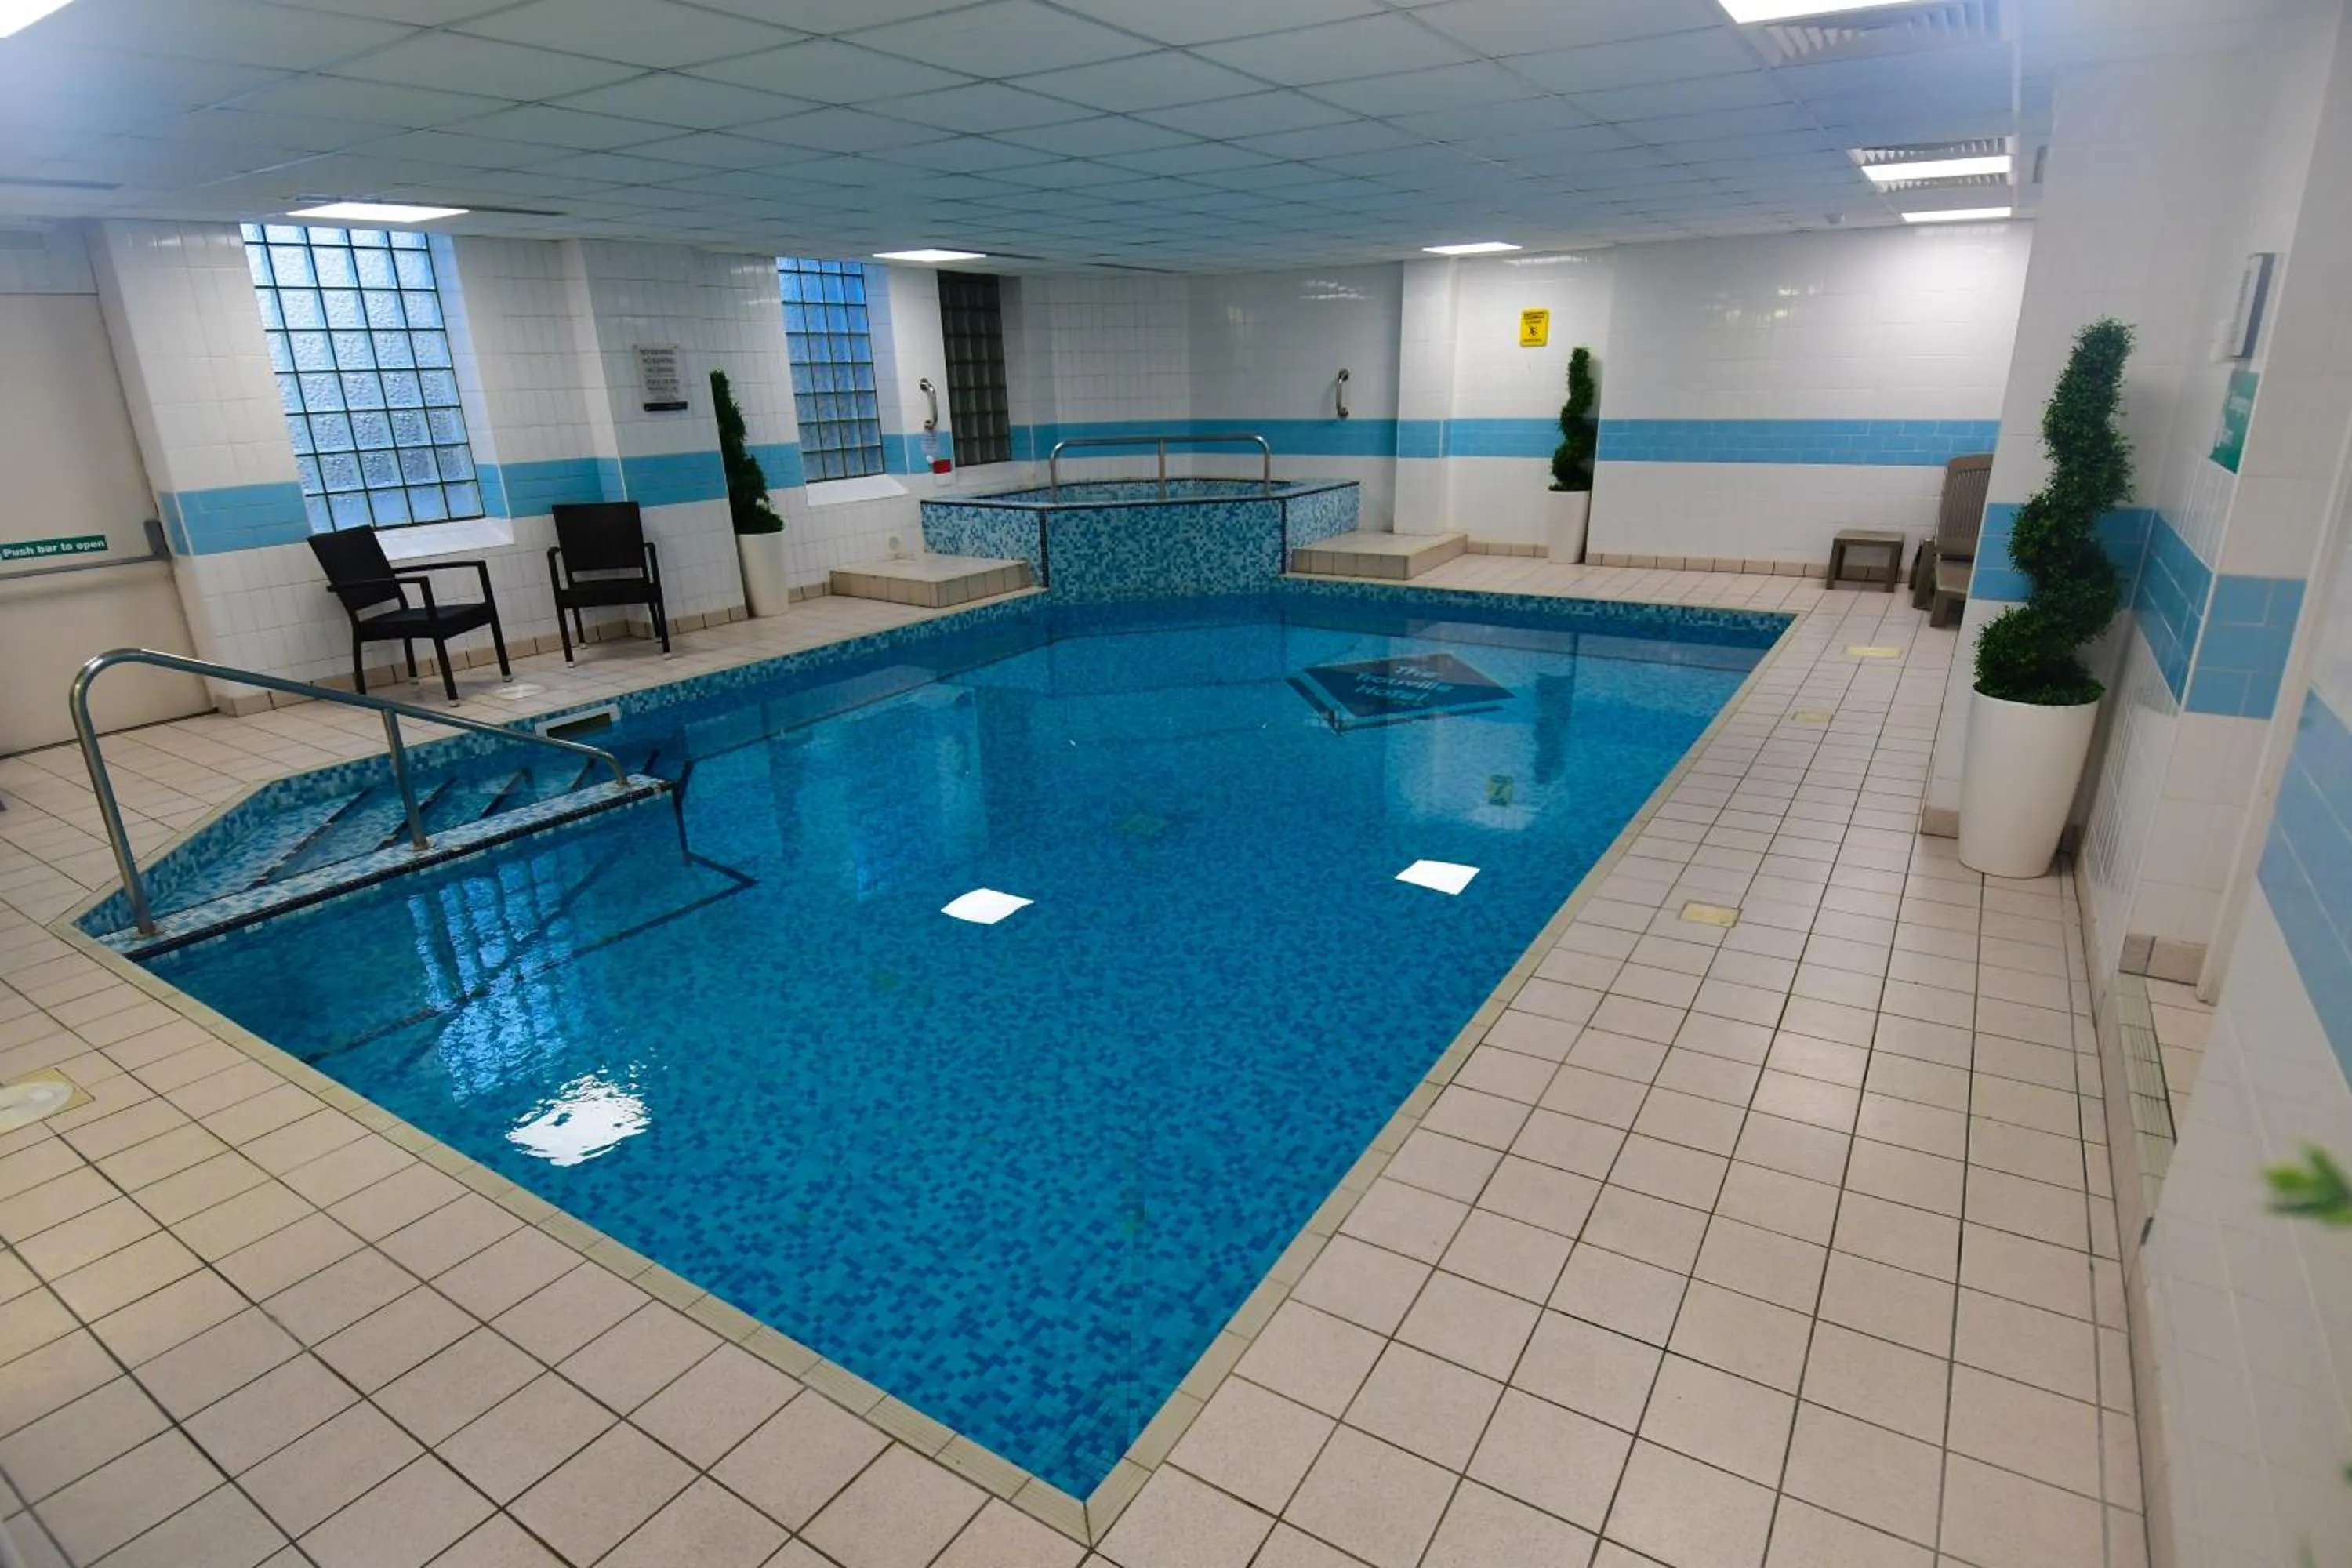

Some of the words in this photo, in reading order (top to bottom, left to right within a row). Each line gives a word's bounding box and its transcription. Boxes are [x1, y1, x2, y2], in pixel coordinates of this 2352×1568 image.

[2, 546, 34, 557] Push
[37, 544, 58, 554] bar
[60, 542, 74, 552] to
[76, 539, 106, 550] open
